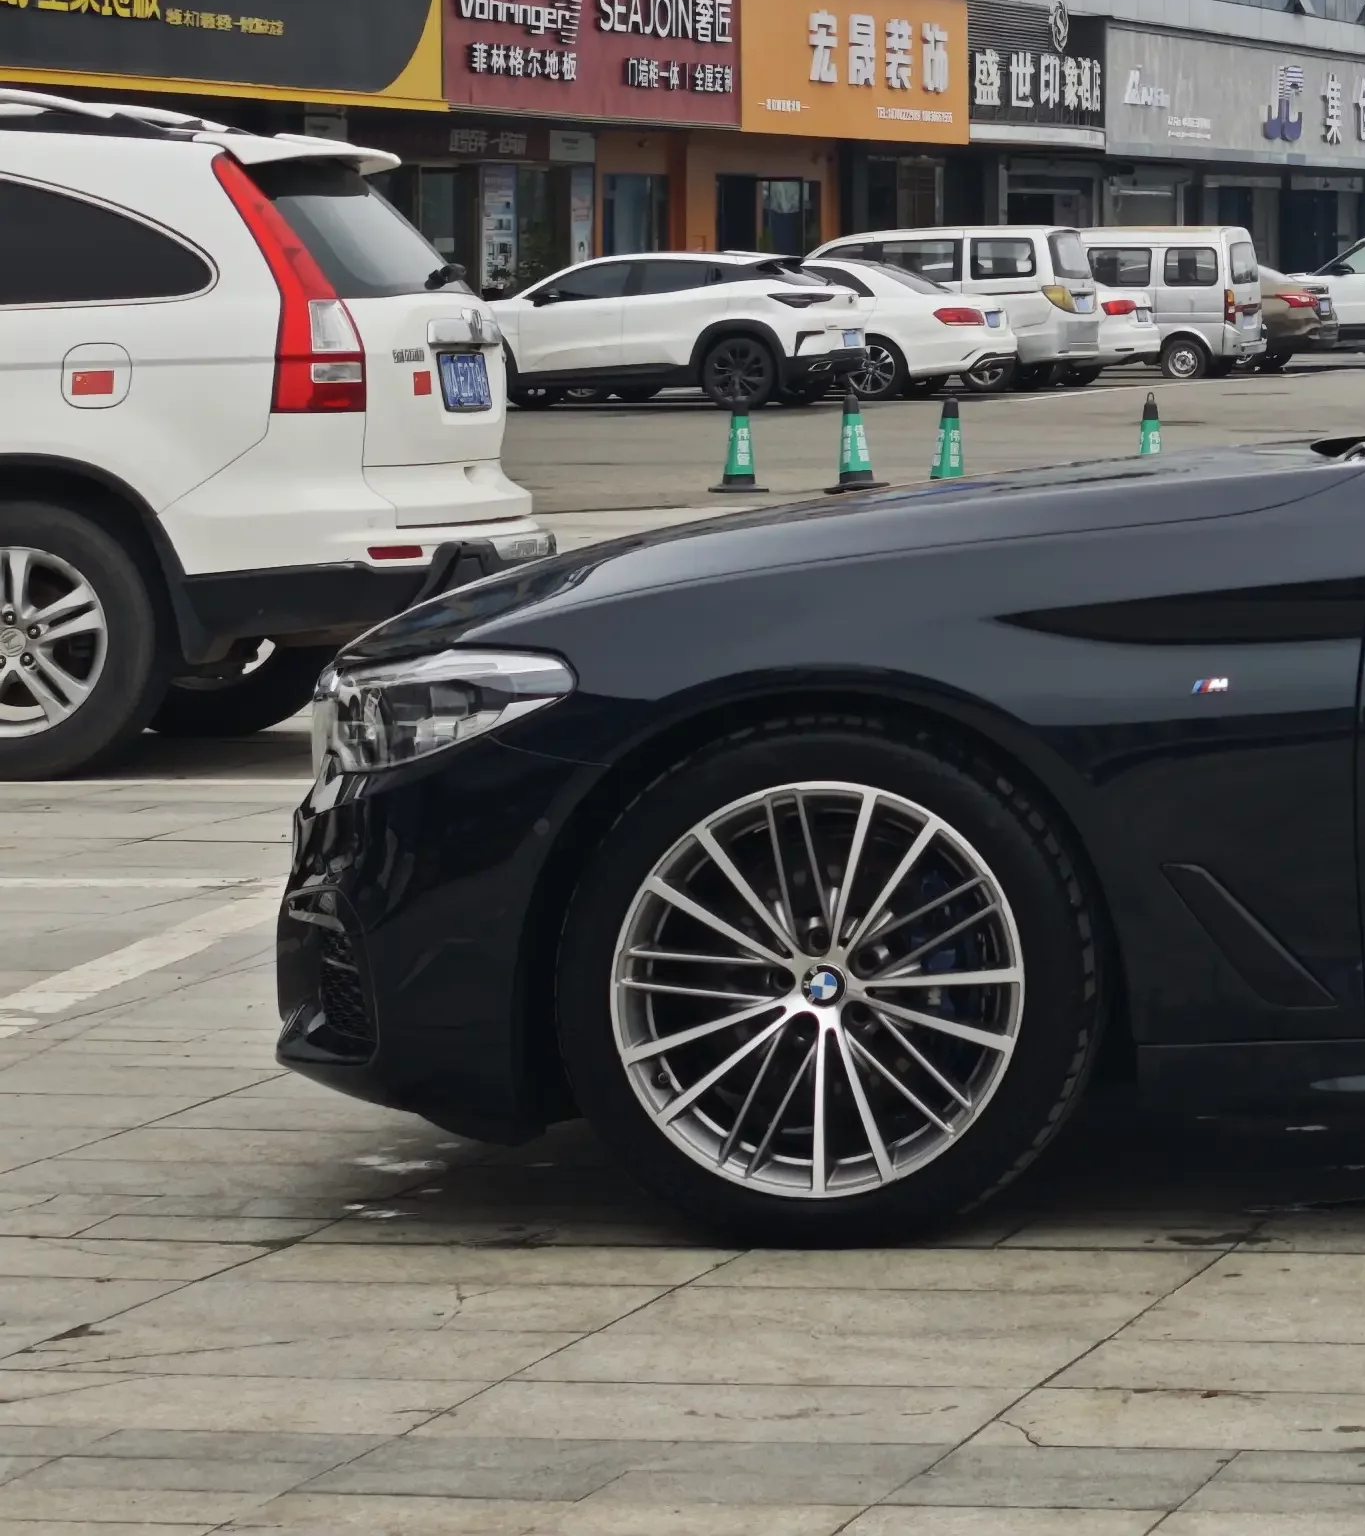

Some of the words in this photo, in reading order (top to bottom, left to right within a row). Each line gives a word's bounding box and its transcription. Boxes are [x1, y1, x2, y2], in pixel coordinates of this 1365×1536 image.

[471, 41, 577, 82] 菲林格尔地板
[808, 9, 949, 94] 宏晟装饰
[974, 48, 1101, 112] 盛世印象酒店
